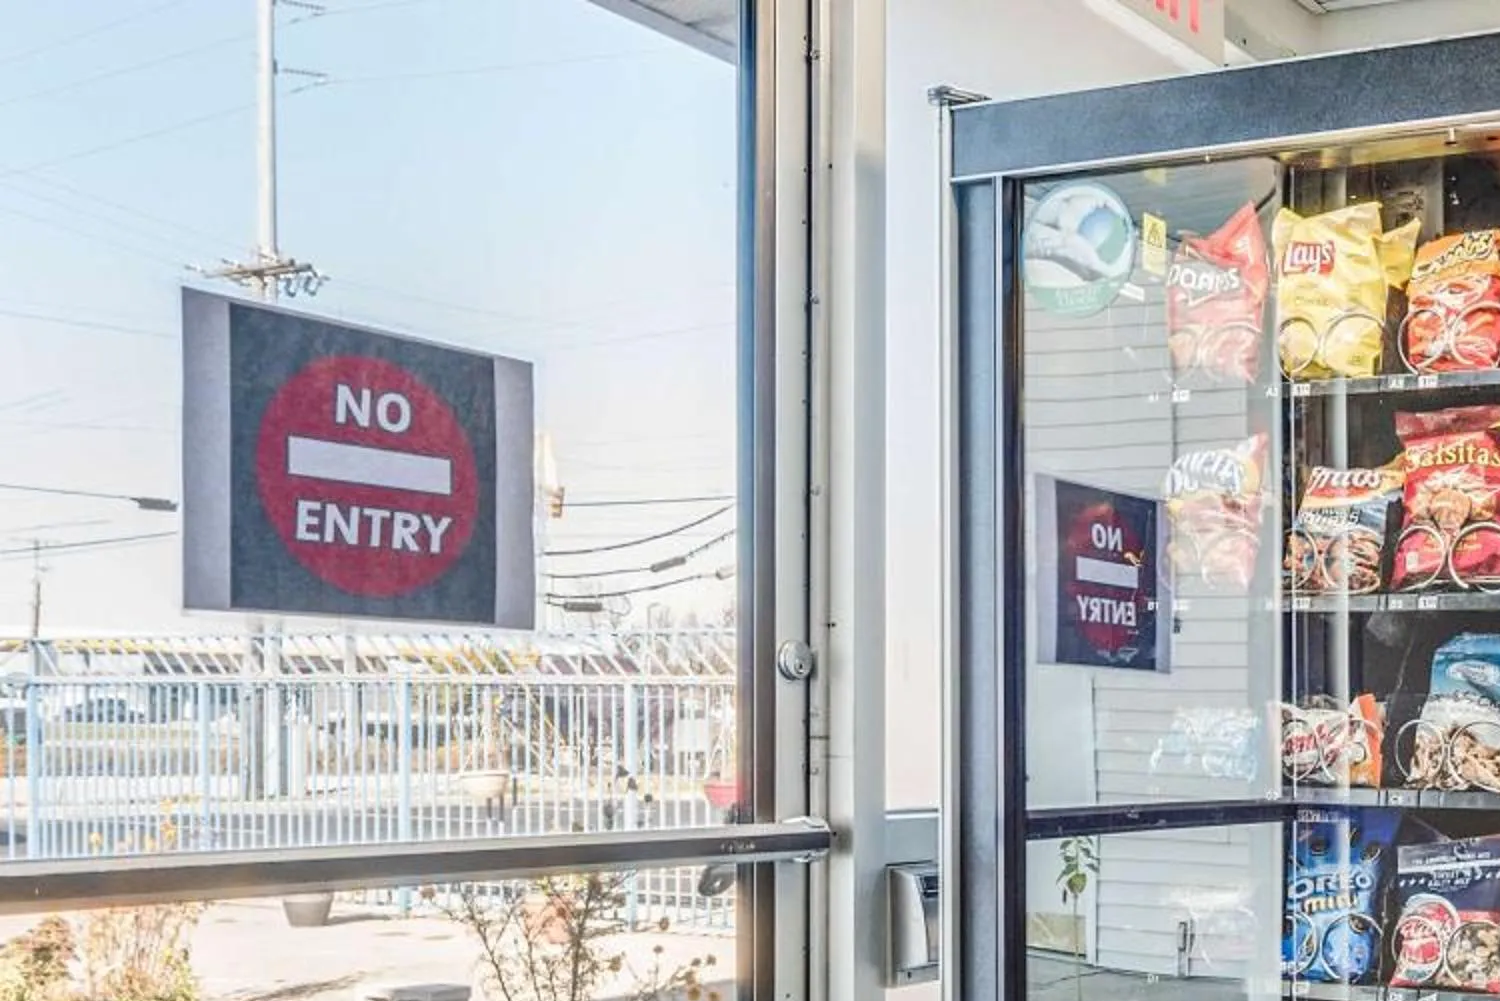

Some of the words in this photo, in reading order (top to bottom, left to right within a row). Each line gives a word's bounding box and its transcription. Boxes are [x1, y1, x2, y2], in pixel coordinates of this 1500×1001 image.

[335, 384, 412, 433] NO
[295, 499, 452, 554] ENTRY
[1288, 870, 1373, 899] OREO
